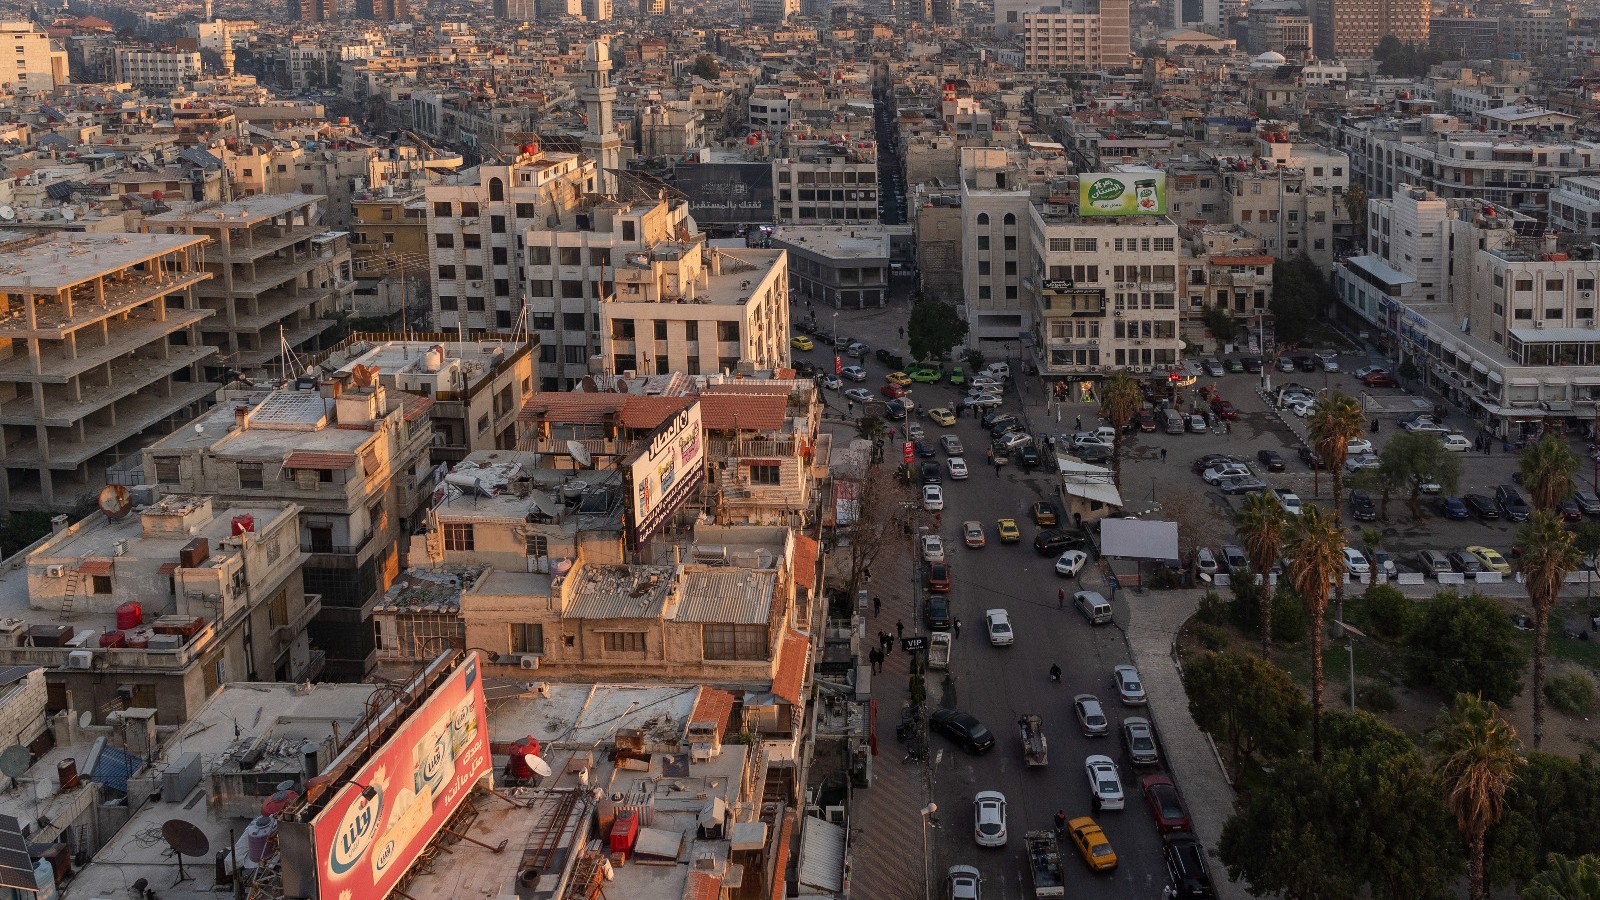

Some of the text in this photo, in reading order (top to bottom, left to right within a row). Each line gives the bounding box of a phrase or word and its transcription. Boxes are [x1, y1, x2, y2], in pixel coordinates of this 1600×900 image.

[1091, 183, 1121, 199] البستان
[688, 200, 762, 211] ثقتك بالمستقبل
[907, 639, 922, 647] VIP
[463, 738, 483, 766] بعدك
[460, 773, 469, 786] ما
[342, 805, 371, 855] Lily
